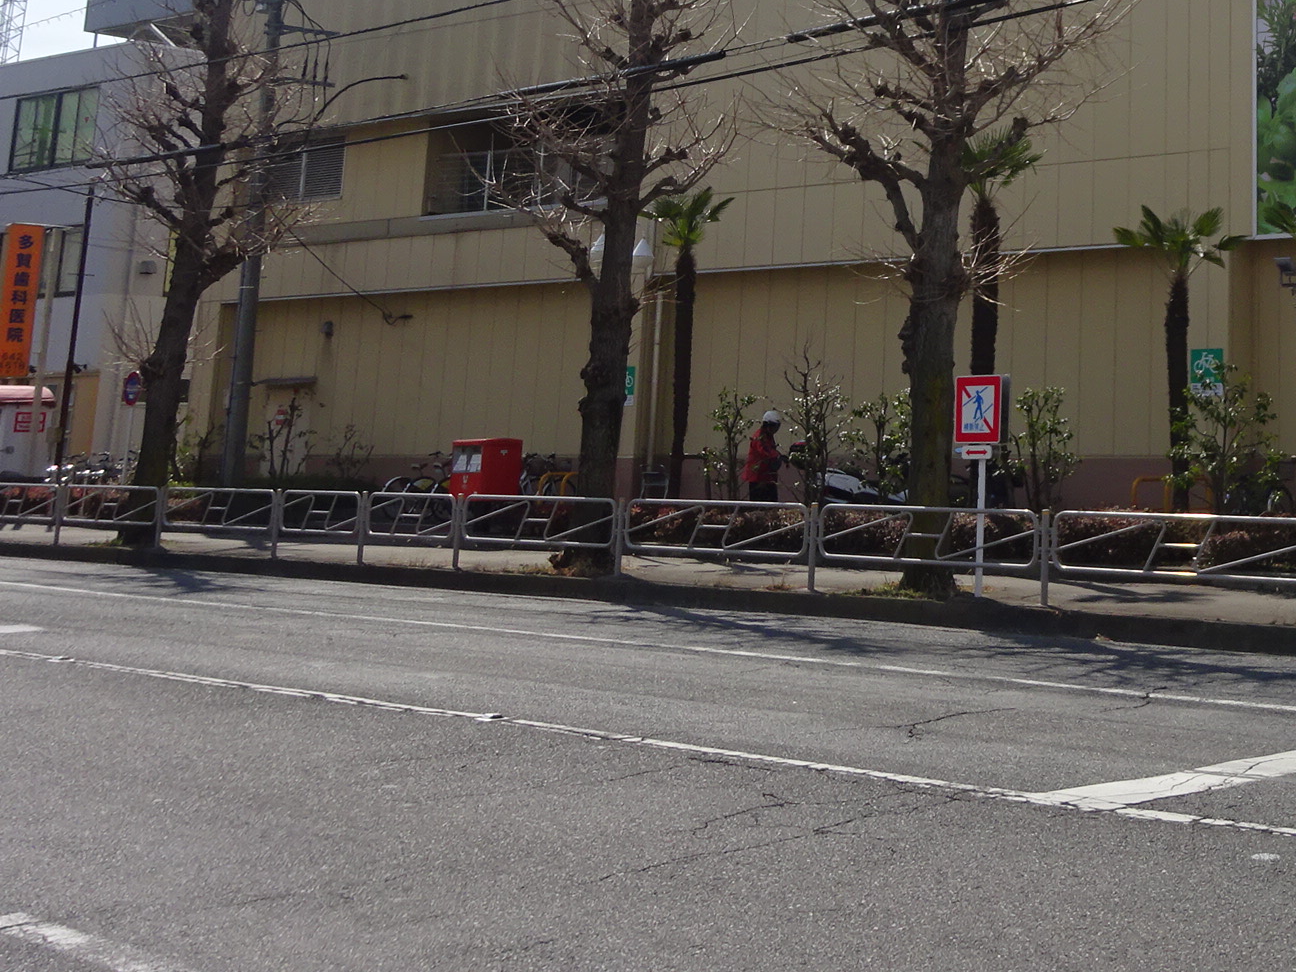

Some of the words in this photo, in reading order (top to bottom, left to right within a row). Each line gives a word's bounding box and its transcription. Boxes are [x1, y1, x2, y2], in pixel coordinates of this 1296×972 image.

[6, 234, 33, 343] 多賀歯科医院
